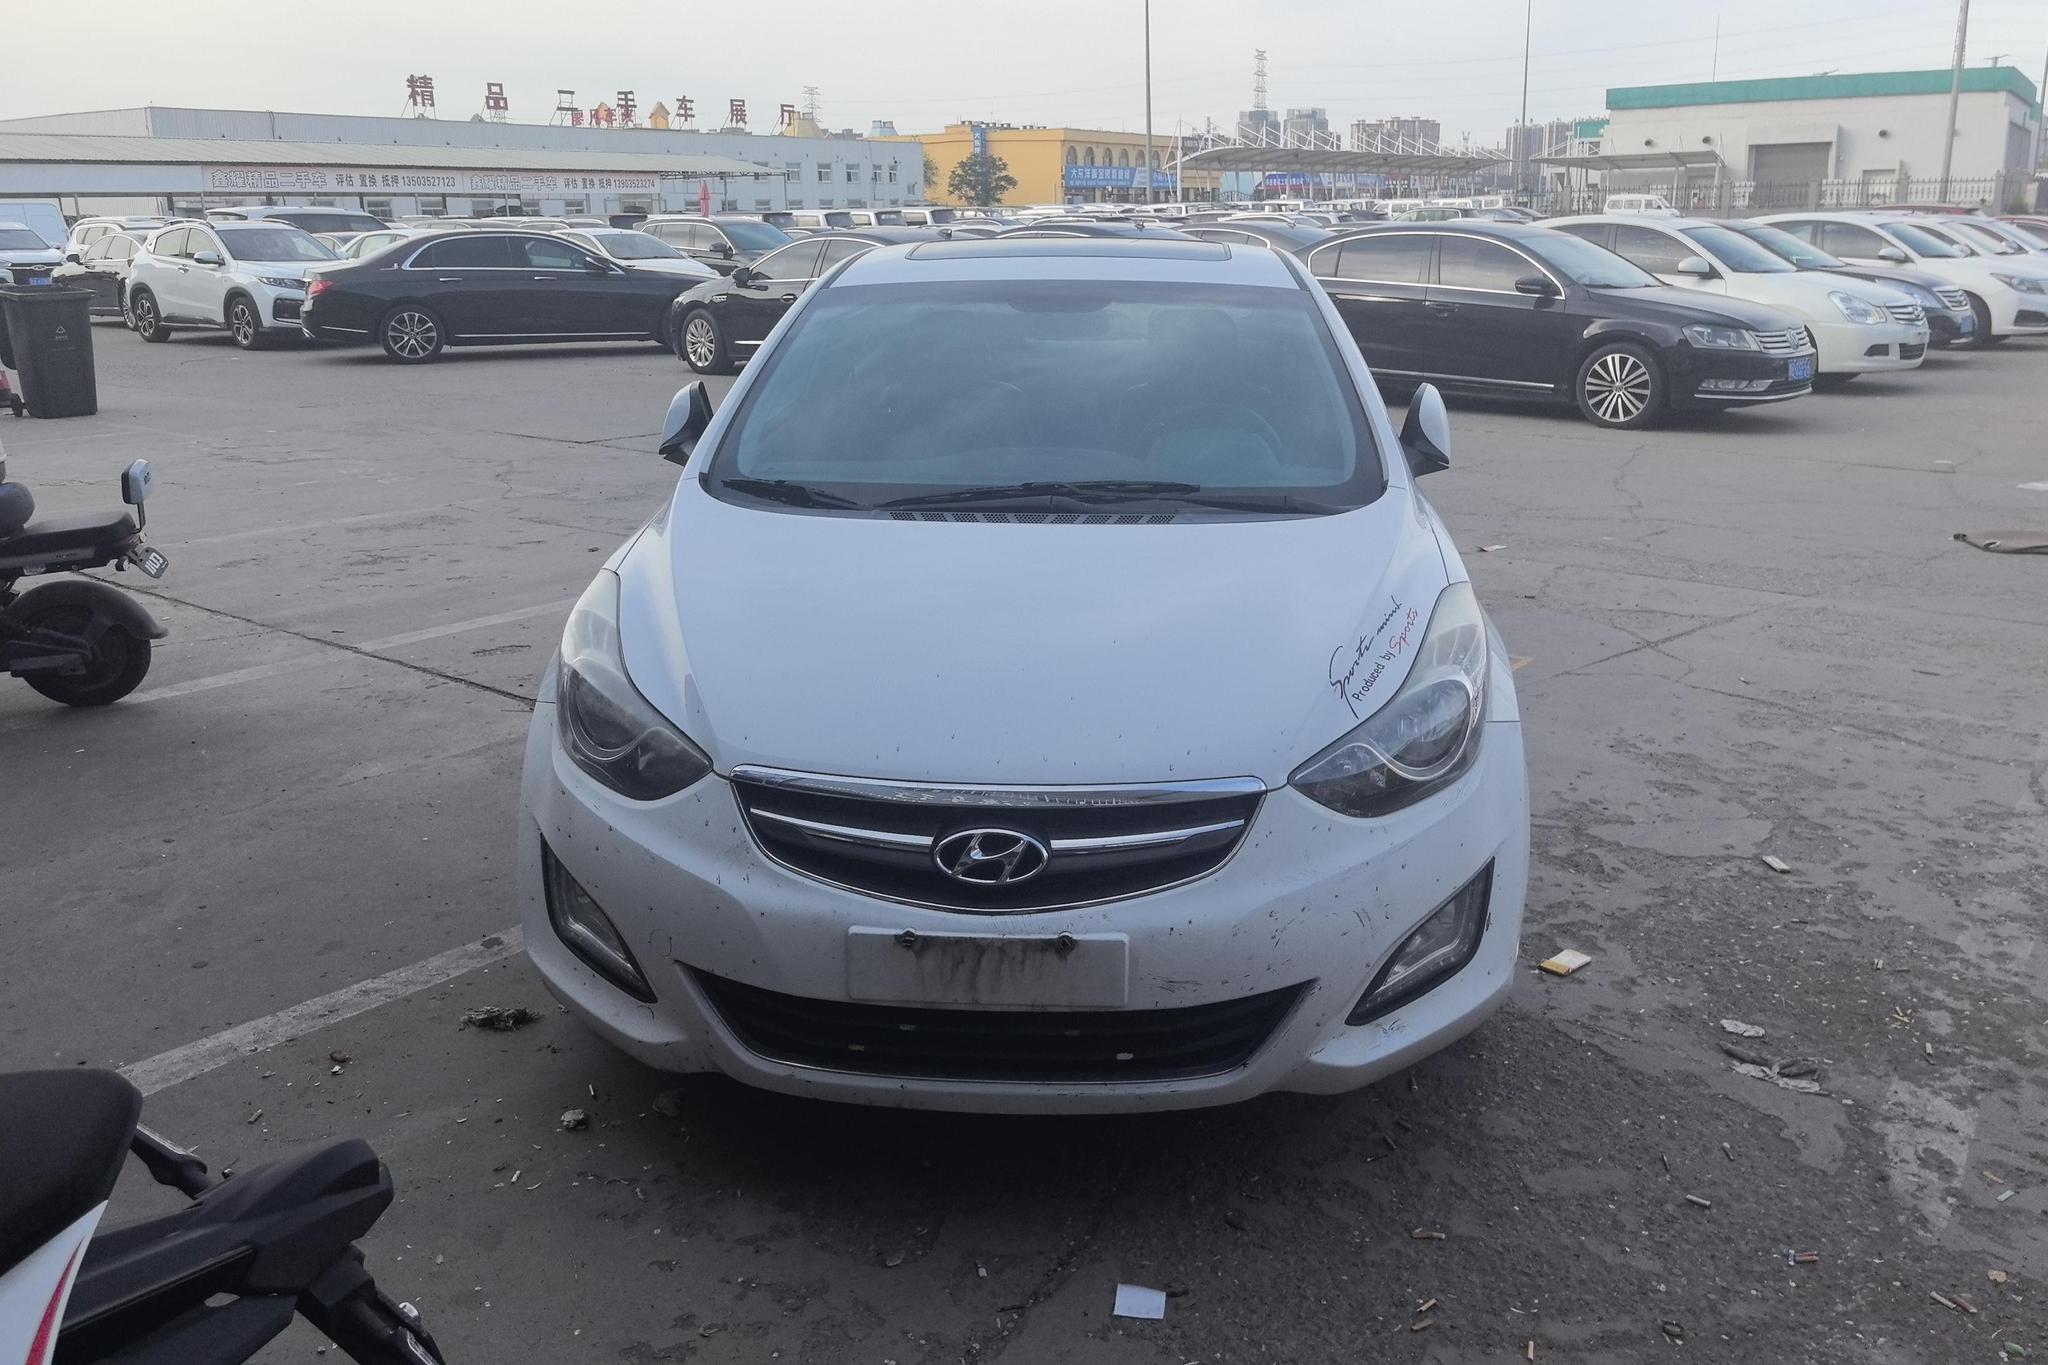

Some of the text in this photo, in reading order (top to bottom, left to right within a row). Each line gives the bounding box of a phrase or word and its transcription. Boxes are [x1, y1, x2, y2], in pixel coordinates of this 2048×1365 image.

[211, 169, 456, 189] 鑫耀精品二手车 评估 置换 抵押 13503527123
[471, 174, 558, 191] 鑫耀精品二手车
[564, 177, 577, 189] 评估
[1376, 594, 1402, 636] mind
[1351, 607, 1418, 702] Produced by Sports
